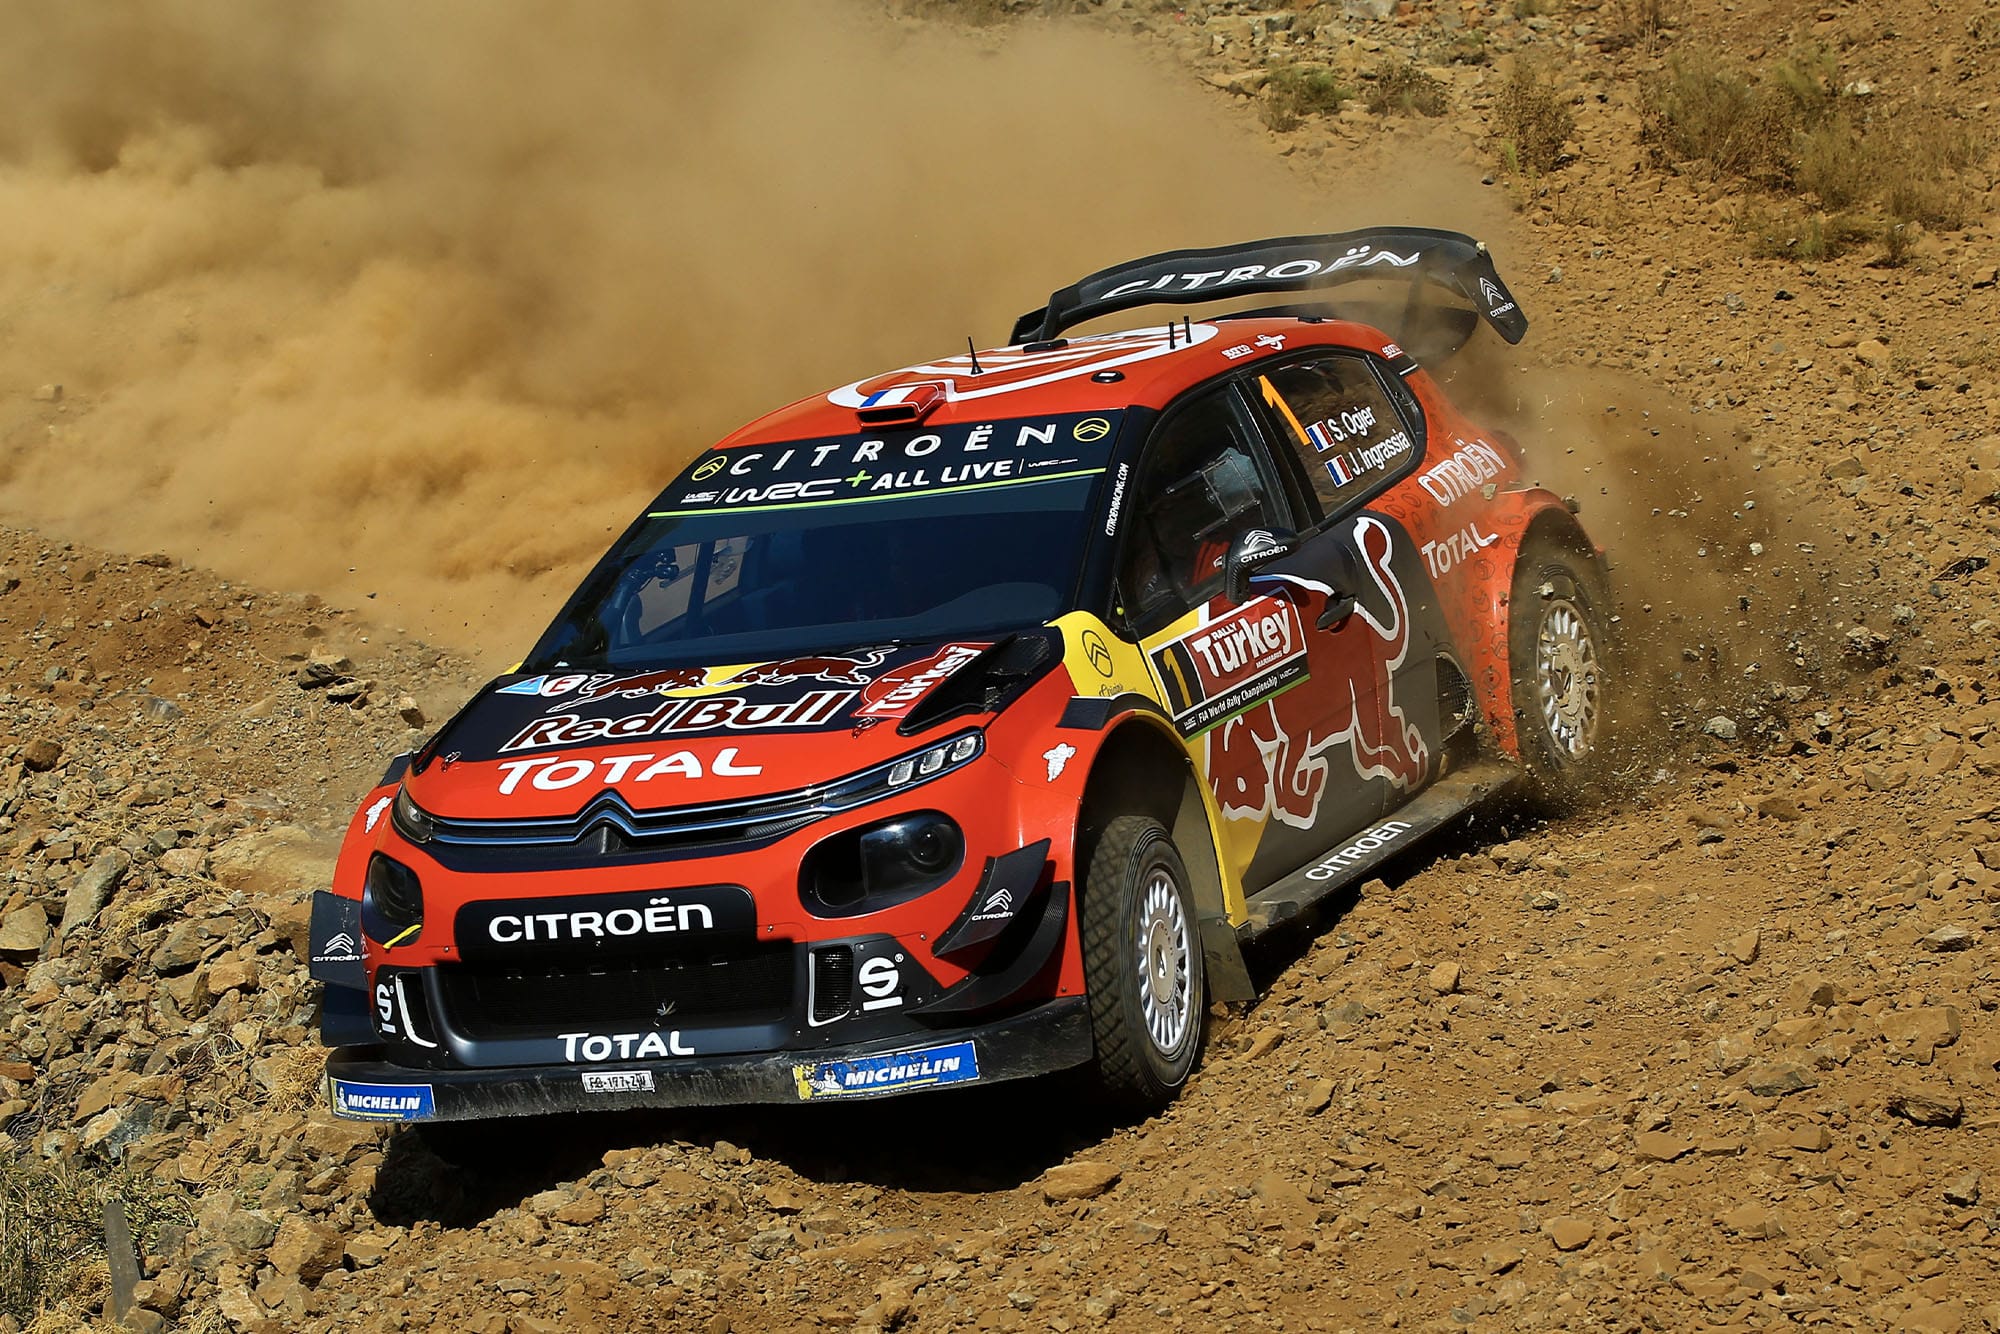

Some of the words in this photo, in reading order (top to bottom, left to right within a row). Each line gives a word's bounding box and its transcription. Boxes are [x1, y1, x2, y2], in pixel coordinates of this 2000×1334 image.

[1100, 245, 1421, 299] CITROËN
[1258, 374, 1311, 446] 1
[1328, 419, 1346, 442] S.
[1341, 404, 1376, 438] Ogier
[729, 423, 1057, 476] CITROËN
[1350, 456, 1364, 476] J.
[1363, 429, 1410, 470] Ingrassia
[1417, 439, 1507, 507] CITROËN
[871, 470, 930, 491] ALL
[942, 459, 1014, 483] LIVE
[1105, 462, 1129, 537] CITROENRACING.COM
[1240, 545, 1288, 563] CITROËN
[1421, 522, 1499, 579] TOTAL
[1191, 608, 1291, 678] Turkey
[1211, 622, 1237, 640] RALLY
[550, 677, 573, 692] E
[1163, 647, 1193, 708] 1
[1198, 711, 1209, 724] FIA
[1208, 703, 1226, 720] World
[1227, 694, 1240, 709] Rally
[1240, 676, 1278, 701] Championship
[499, 700, 678, 752] Red
[661, 689, 858, 734] Bull
[497, 748, 763, 795] TOTAL
[1305, 821, 1412, 880] CITROËN
[488, 897, 713, 943] CITROËN
[971, 910, 1014, 921] CITROËN
[557, 1030, 695, 1062] TOTAL
[844, 1056, 961, 1087] MICHELIN
[348, 1093, 421, 1110] MICHELIN
